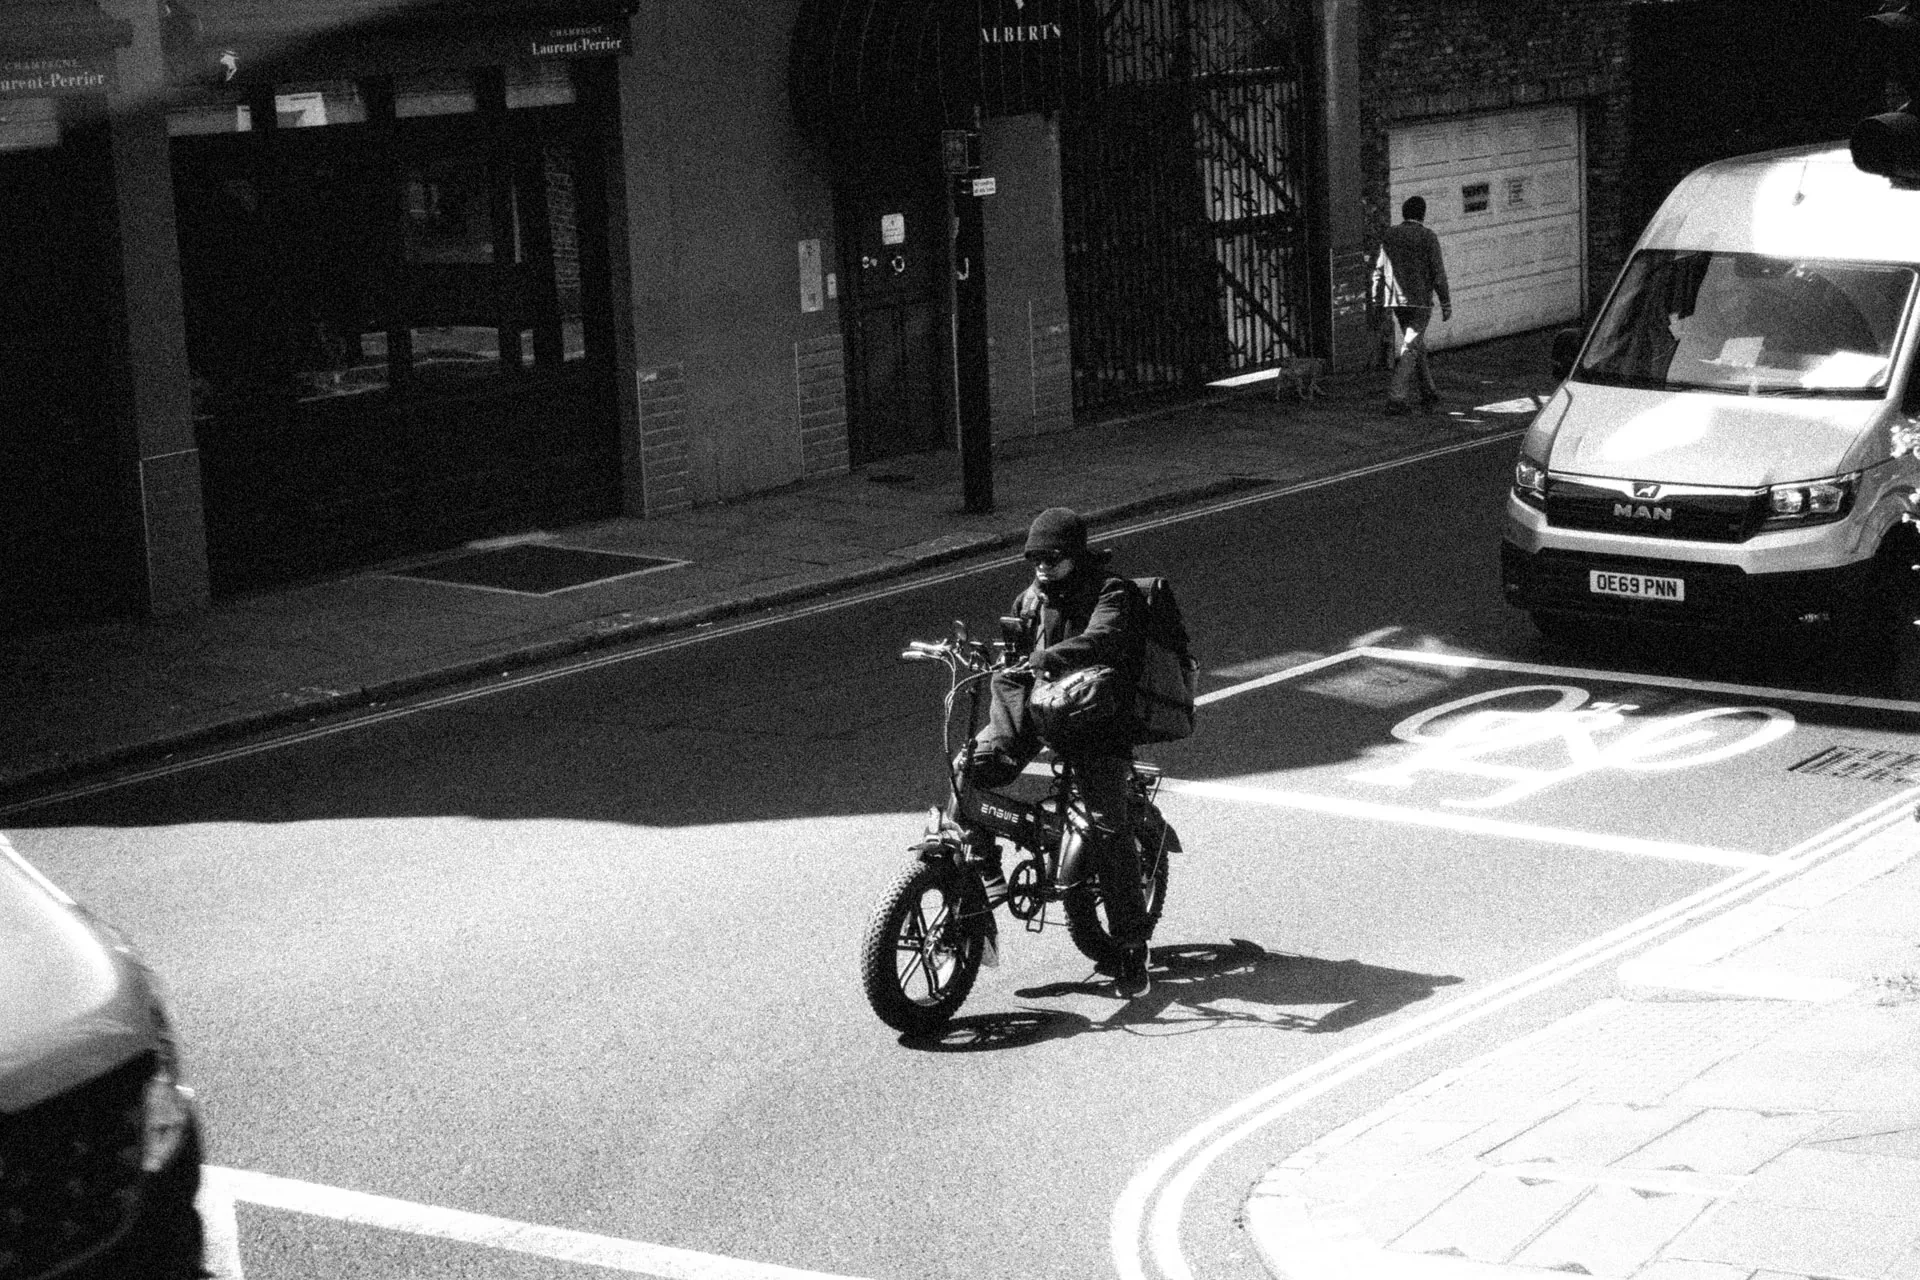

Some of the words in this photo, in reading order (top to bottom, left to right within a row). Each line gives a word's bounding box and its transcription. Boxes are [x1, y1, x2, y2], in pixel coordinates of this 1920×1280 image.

[549, 26, 603, 38] CHAMPAGNE
[982, 22, 1061, 43] ALBERT'S
[531, 36, 622, 56] Laurent-Perrier
[1613, 503, 1672, 521] MAN
[1597, 574, 1639, 594] OE69
[1644, 578, 1677, 598] PNN
